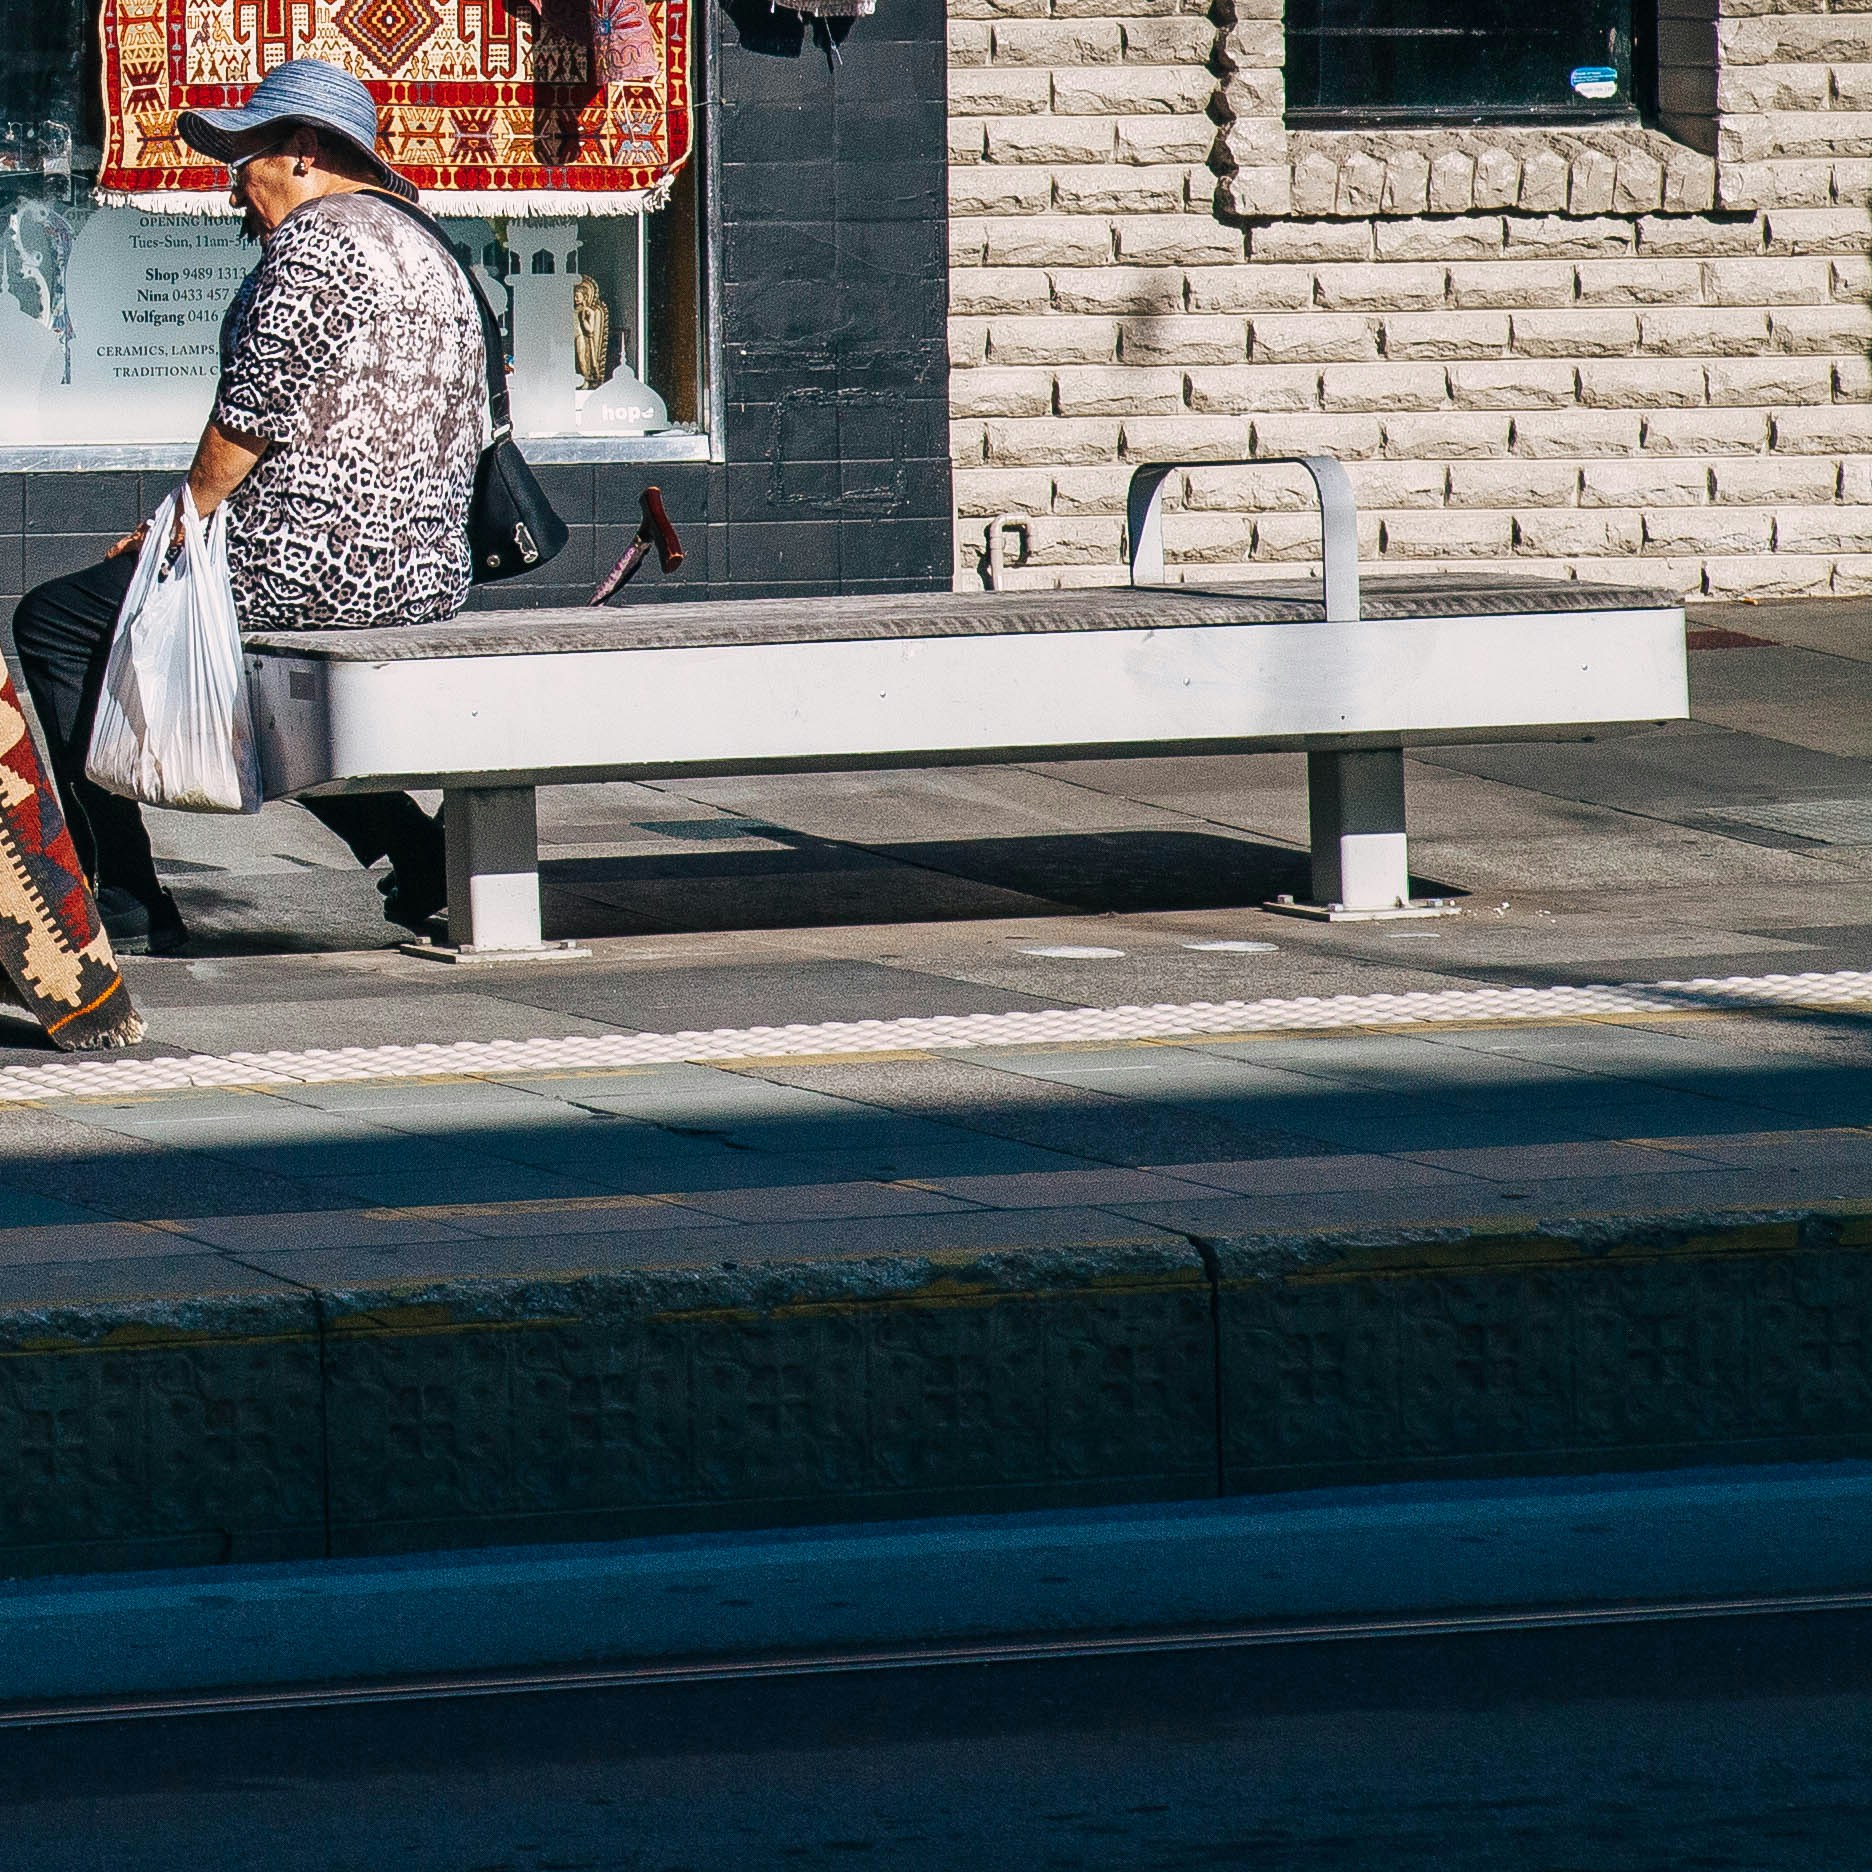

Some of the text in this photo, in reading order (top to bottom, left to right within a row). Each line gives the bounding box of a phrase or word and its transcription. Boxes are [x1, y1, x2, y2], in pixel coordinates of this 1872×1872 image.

[139, 216, 201, 228] OPENING
[129, 234, 193, 250] Tues-Sun,
[145, 267, 247, 283] Shop 9489 1313
[136, 289, 169, 302] Nina
[172, 289, 203, 302] 0433
[207, 288, 230, 302] 457
[121, 310, 185, 326] Wolfgang
[188, 310, 219, 322] 0416
[96, 345, 219, 357] CERAMICS, LAMPS,
[113, 366, 206, 378] TRADITIONAL
[602, 403, 654, 422] hope
